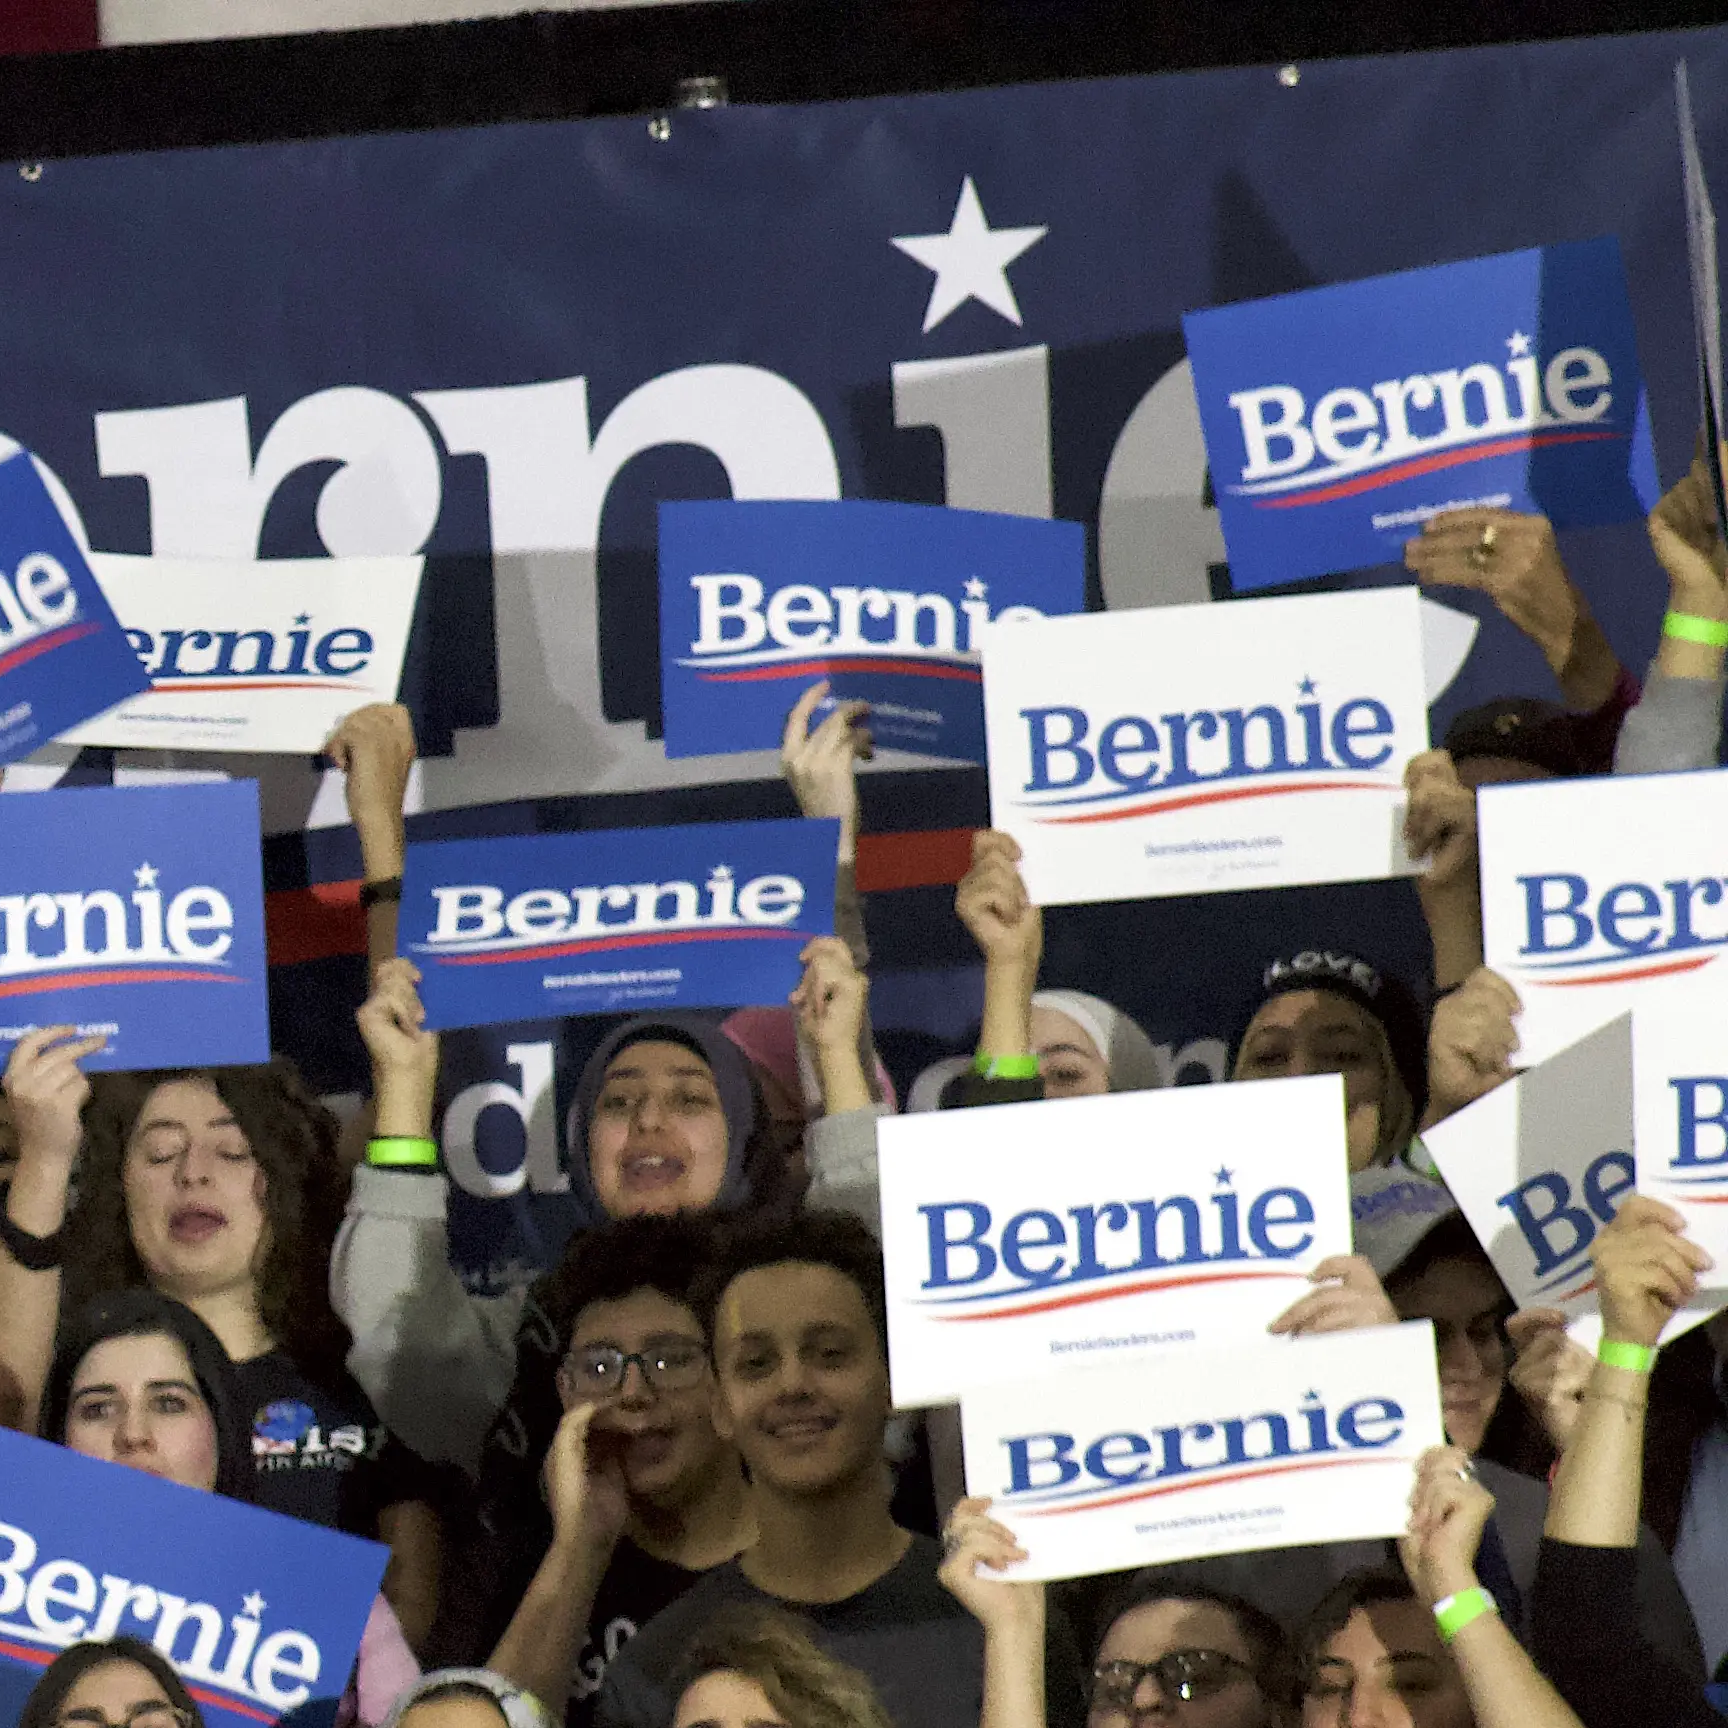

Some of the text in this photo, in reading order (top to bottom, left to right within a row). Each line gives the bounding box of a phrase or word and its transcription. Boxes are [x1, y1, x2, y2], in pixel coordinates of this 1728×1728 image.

[1229, 330, 1612, 481] Bernie
[124, 612, 374, 677] ernie
[1020, 675, 1396, 793] Bernie
[428, 863, 805, 945] Bernie
[1515, 871, 1728, 957] Ber
[917, 1164, 1317, 1290] Bernie
[1000, 1388, 1405, 1494] Bernie
